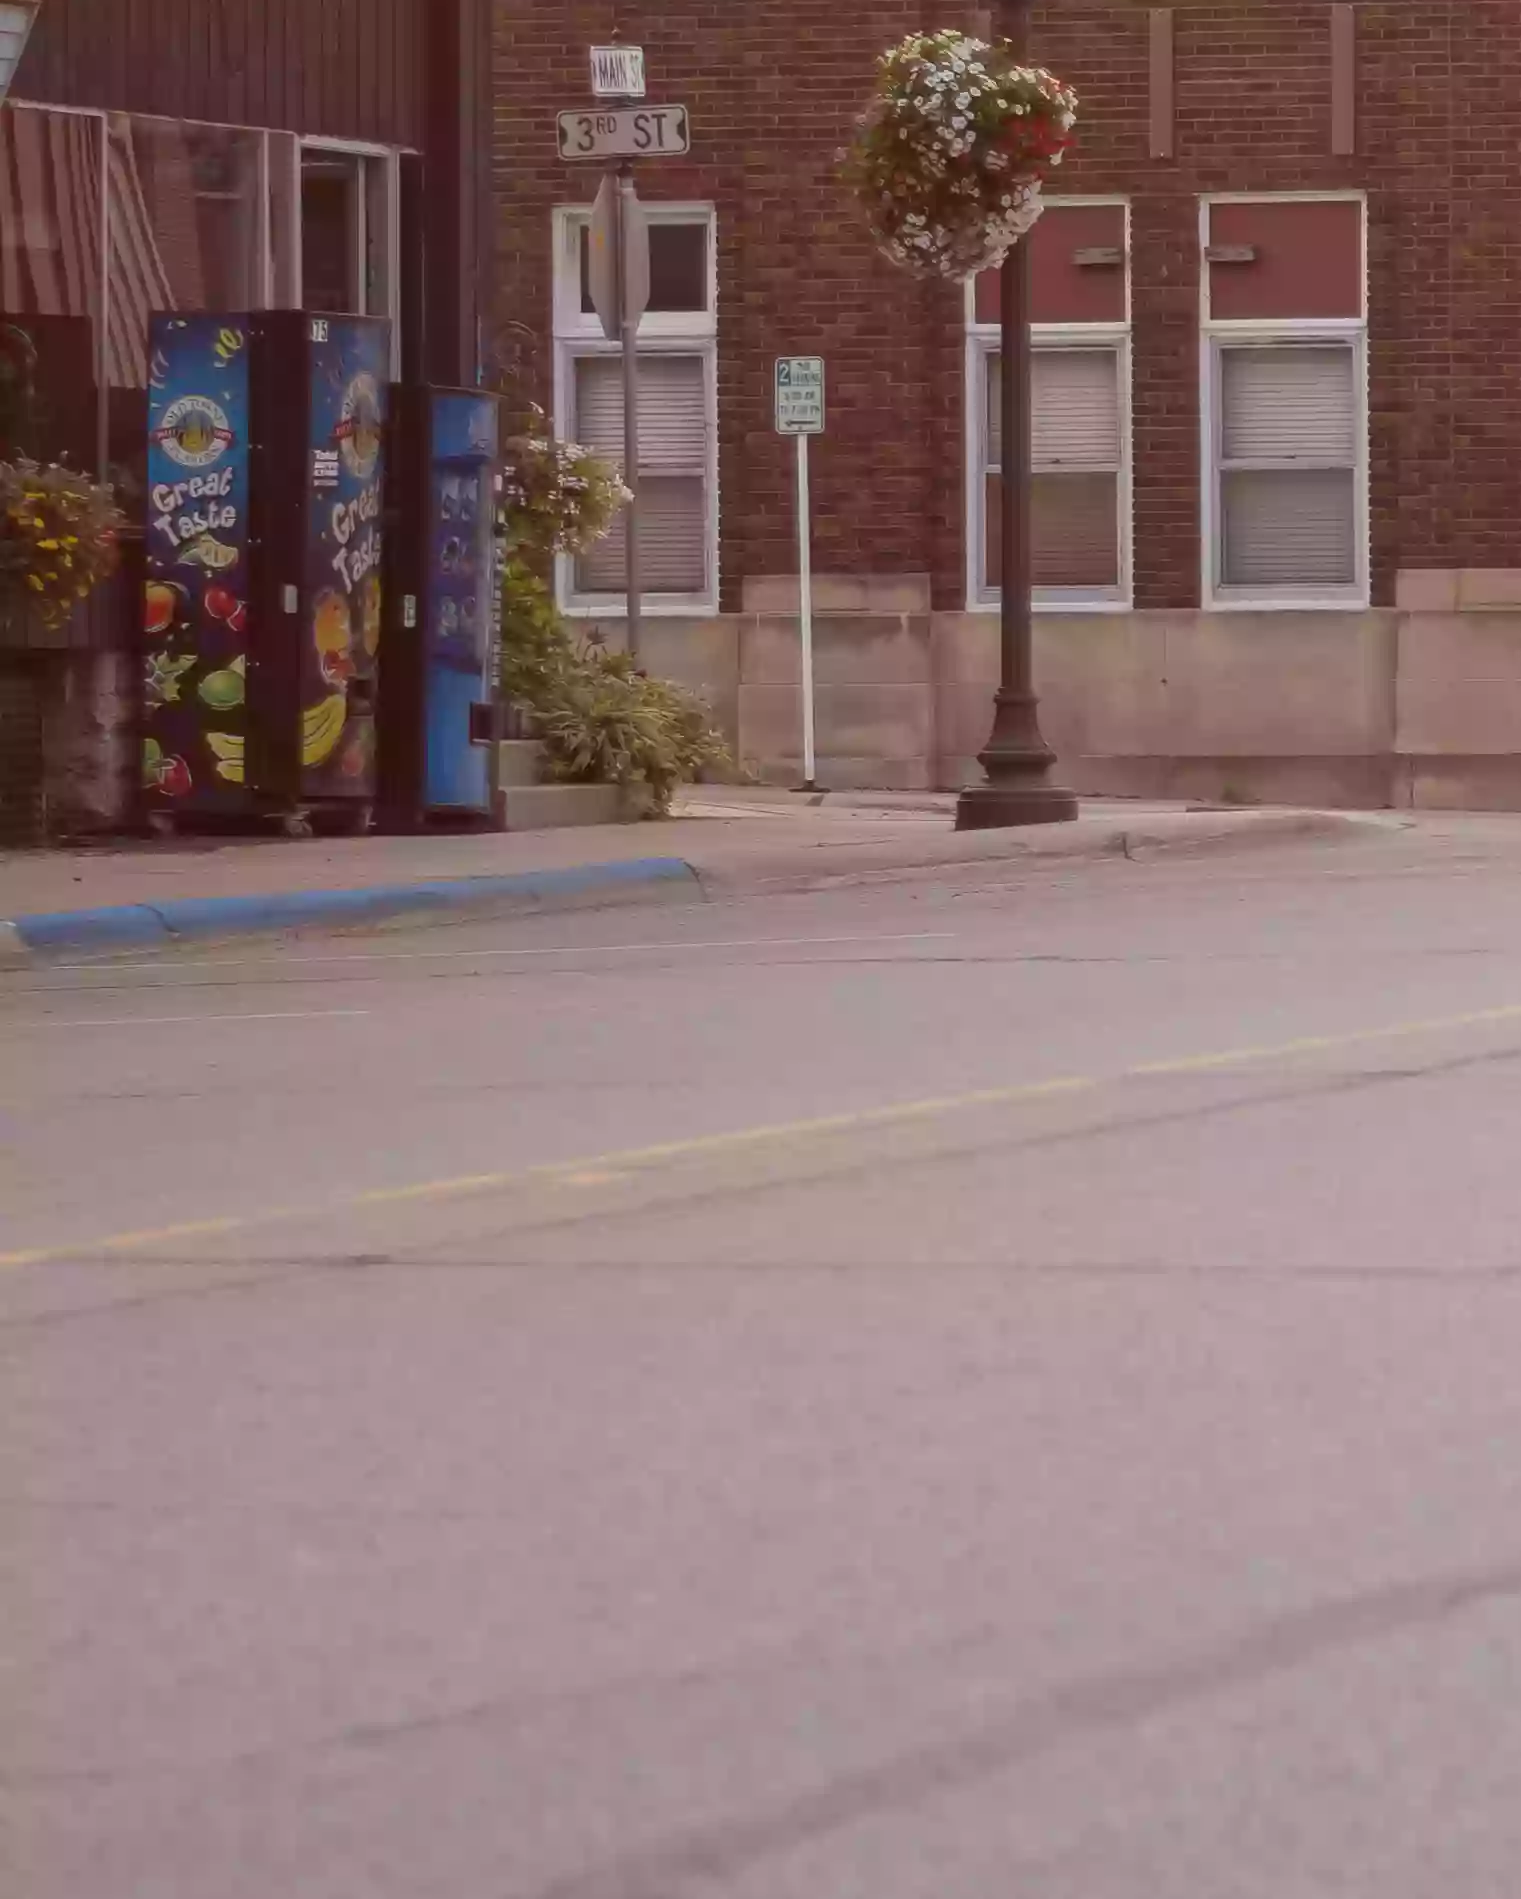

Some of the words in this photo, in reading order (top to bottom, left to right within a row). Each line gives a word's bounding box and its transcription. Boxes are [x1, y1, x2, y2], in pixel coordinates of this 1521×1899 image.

[598, 53, 628, 88] MAIN
[577, 115, 618, 151] 3RD
[633, 113, 667, 149] ST
[153, 466, 234, 513] Great
[153, 501, 238, 547] Taste
